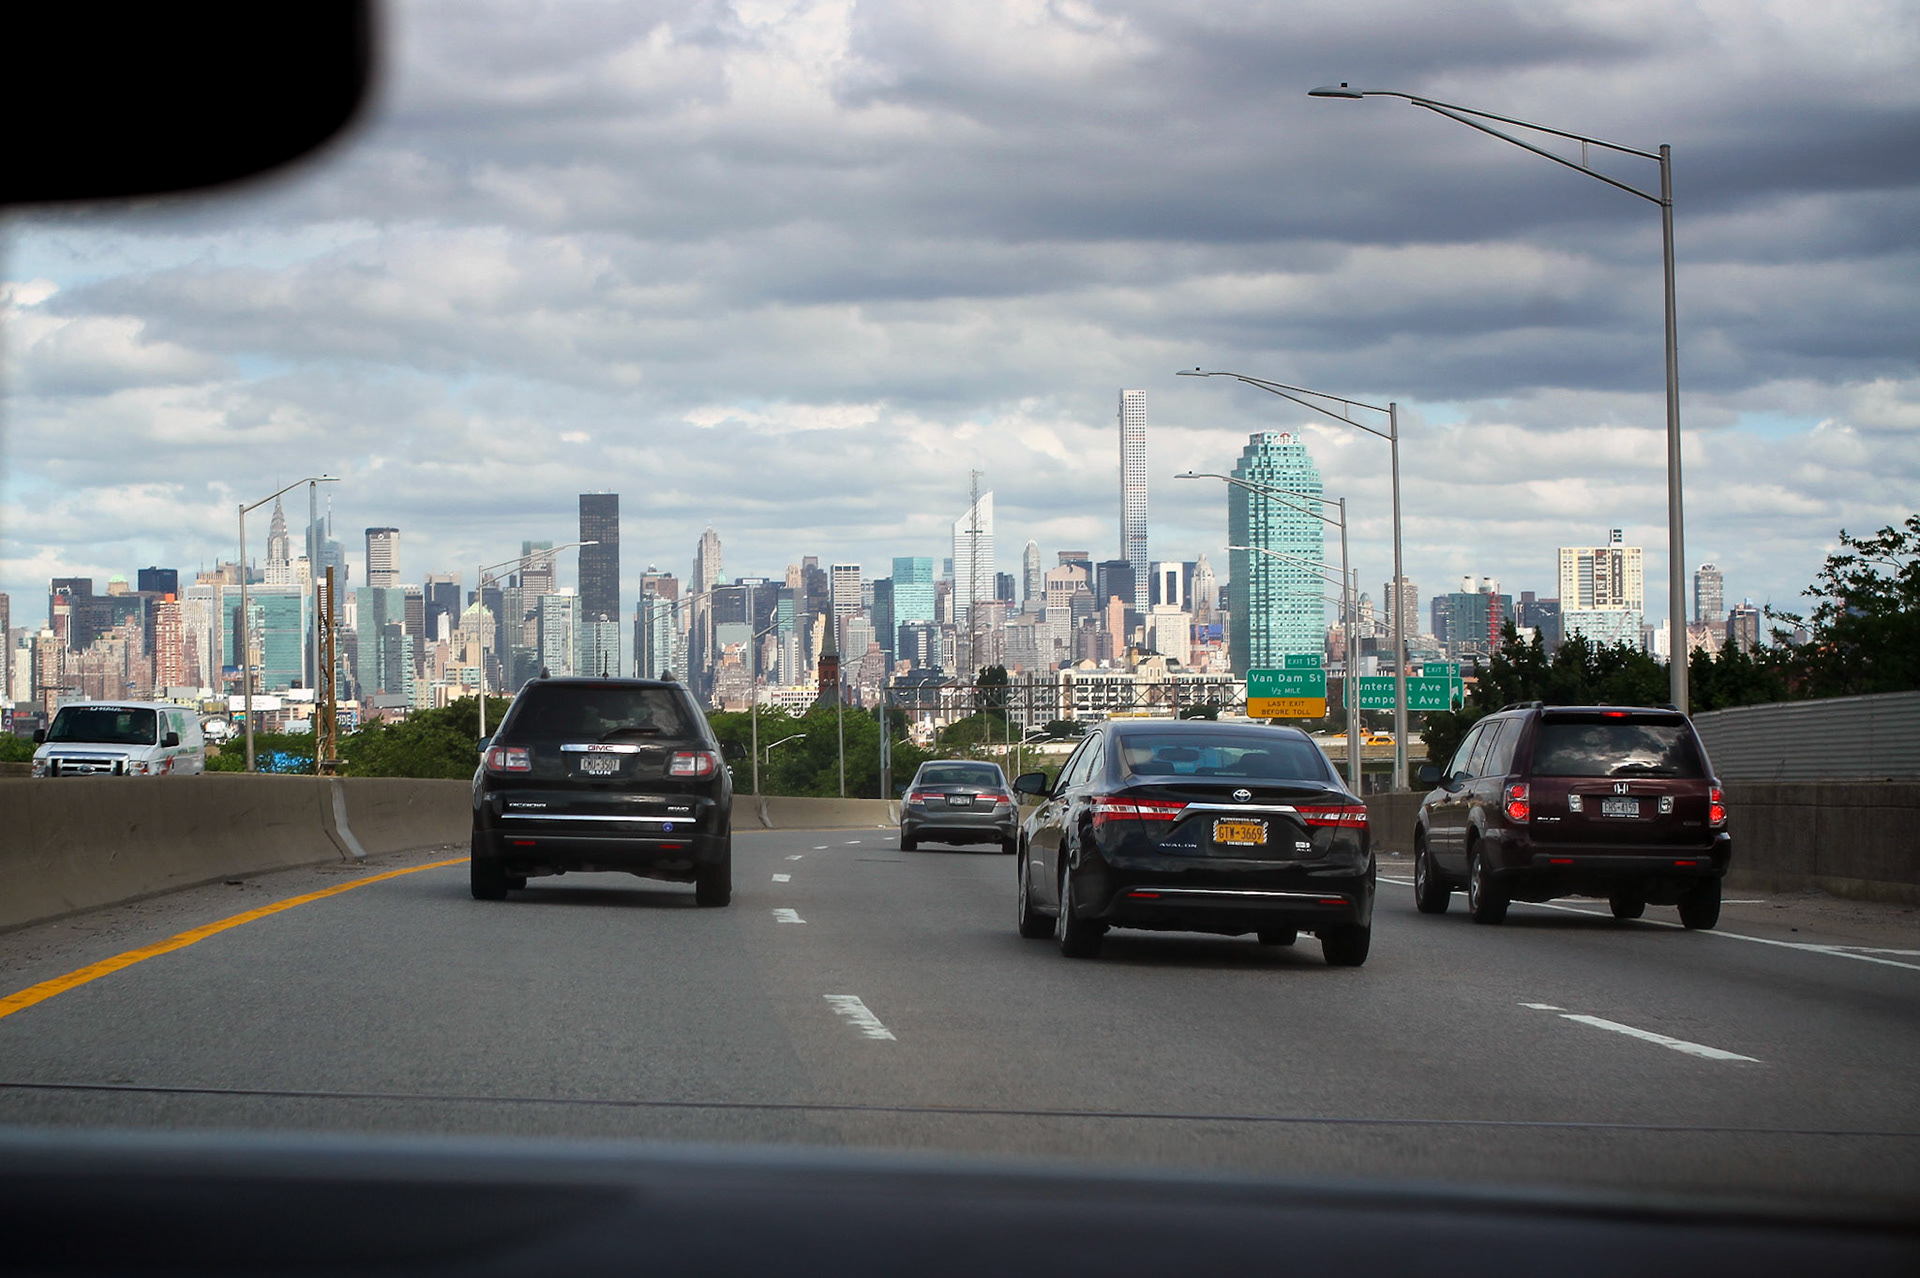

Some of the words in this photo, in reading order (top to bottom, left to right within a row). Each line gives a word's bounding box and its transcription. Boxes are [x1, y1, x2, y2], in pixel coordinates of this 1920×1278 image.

[1306, 657, 1318, 666] 15
[1251, 674, 1273, 682] Van
[1278, 674, 1303, 682] Dam
[1309, 673, 1321, 682] St
[1419, 683, 1441, 691] Ave
[1346, 696, 1413, 706] eenpot
[1419, 696, 1441, 704] Ave
